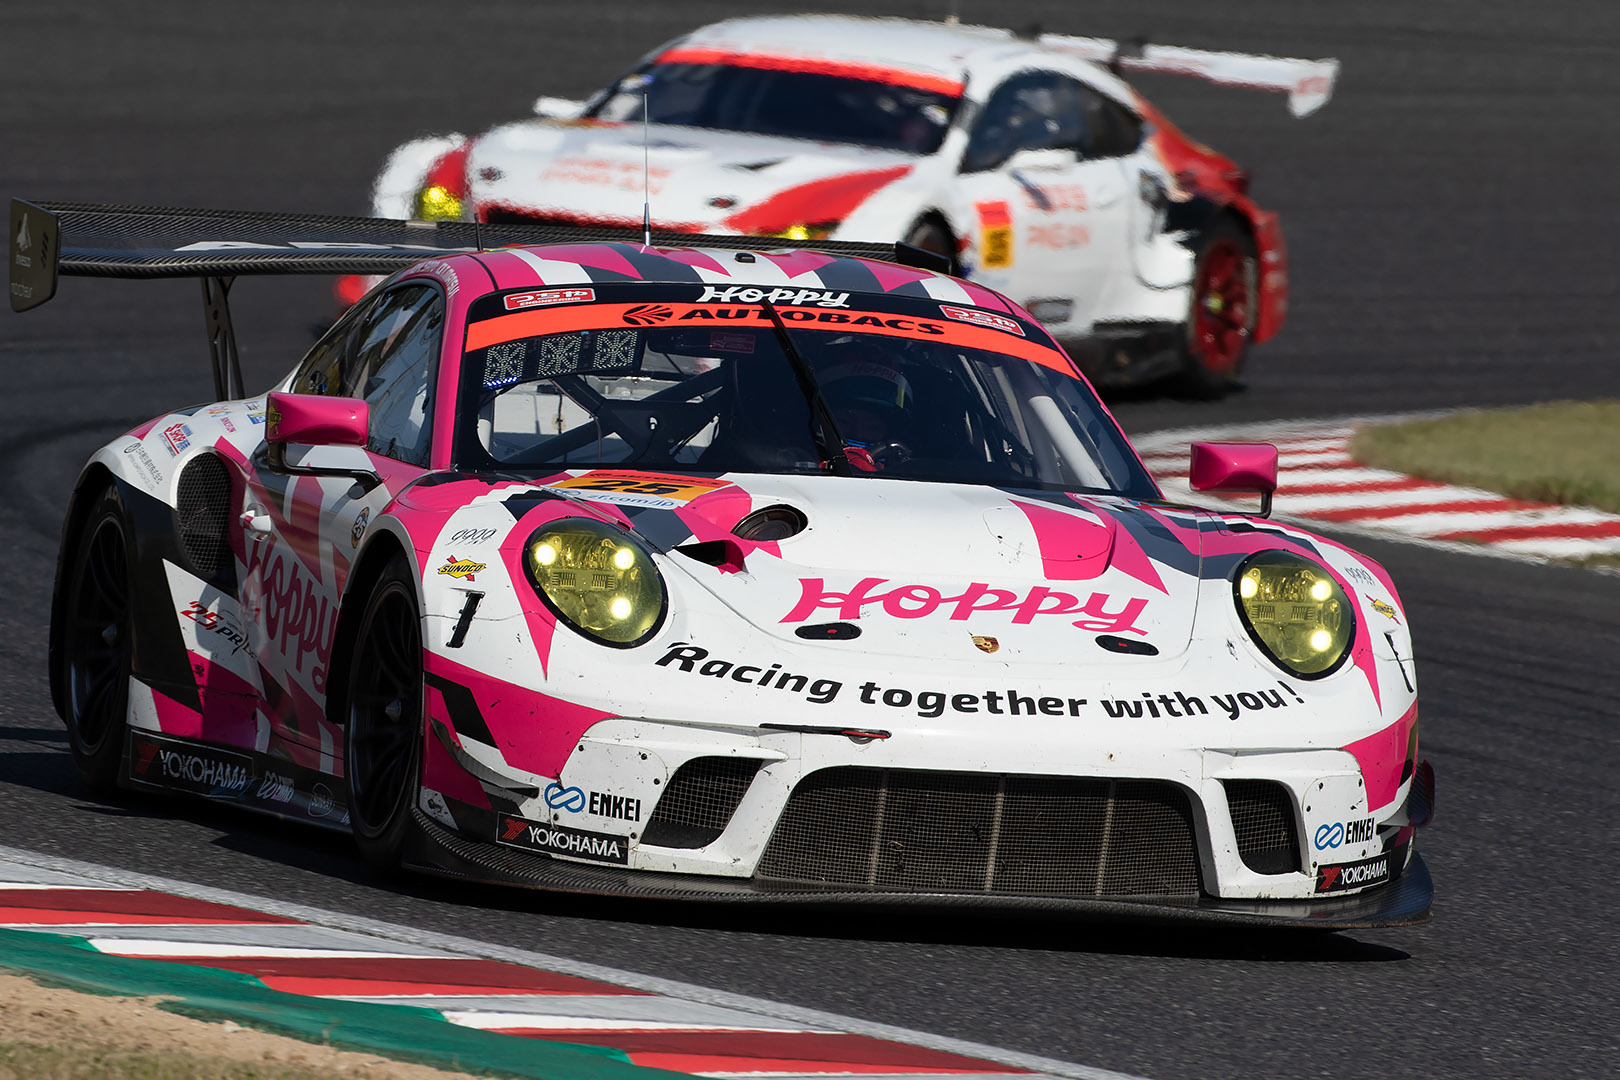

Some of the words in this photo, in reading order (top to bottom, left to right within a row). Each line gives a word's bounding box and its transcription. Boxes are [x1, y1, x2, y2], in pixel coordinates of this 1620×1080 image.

[696, 286, 850, 308] Hoppy
[679, 308, 945, 335] AUTOBACS
[567, 479, 695, 496] 25
[440, 563, 484, 573] SUNOCO
[778, 577, 1149, 637] Hoppy
[655, 642, 843, 704] Racing
[859, 681, 1088, 718] together
[1100, 691, 1209, 718] with
[1210, 680, 1305, 721] you!
[159, 750, 247, 791] YOKOHAMA
[588, 791, 642, 822] ENKEI
[528, 825, 621, 858] YOKOHAMA
[1345, 817, 1375, 844] ENKEI
[1341, 860, 1387, 885] YOKOHAMA
